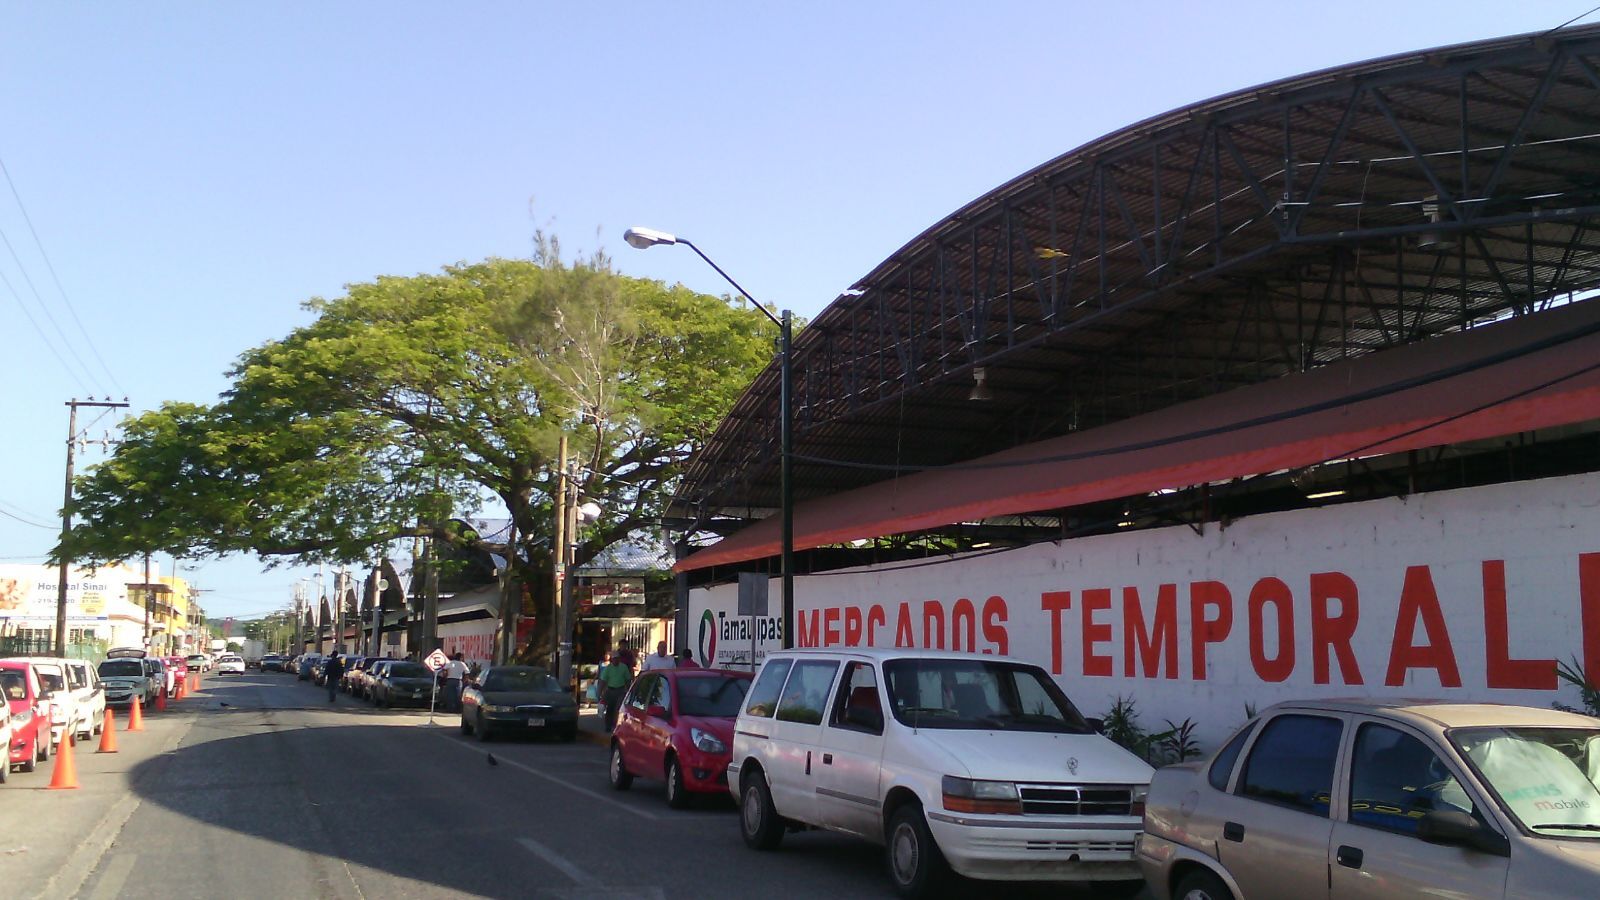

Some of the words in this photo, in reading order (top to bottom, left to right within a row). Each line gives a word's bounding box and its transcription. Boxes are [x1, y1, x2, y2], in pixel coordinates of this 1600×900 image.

[38, 583, 79, 591] Hostal
[82, 583, 107, 591] Sinai
[718, 611, 782, 645] Tamauipas
[797, 595, 1009, 656] MERCADOS
[1534, 798, 1591, 811] mobile
